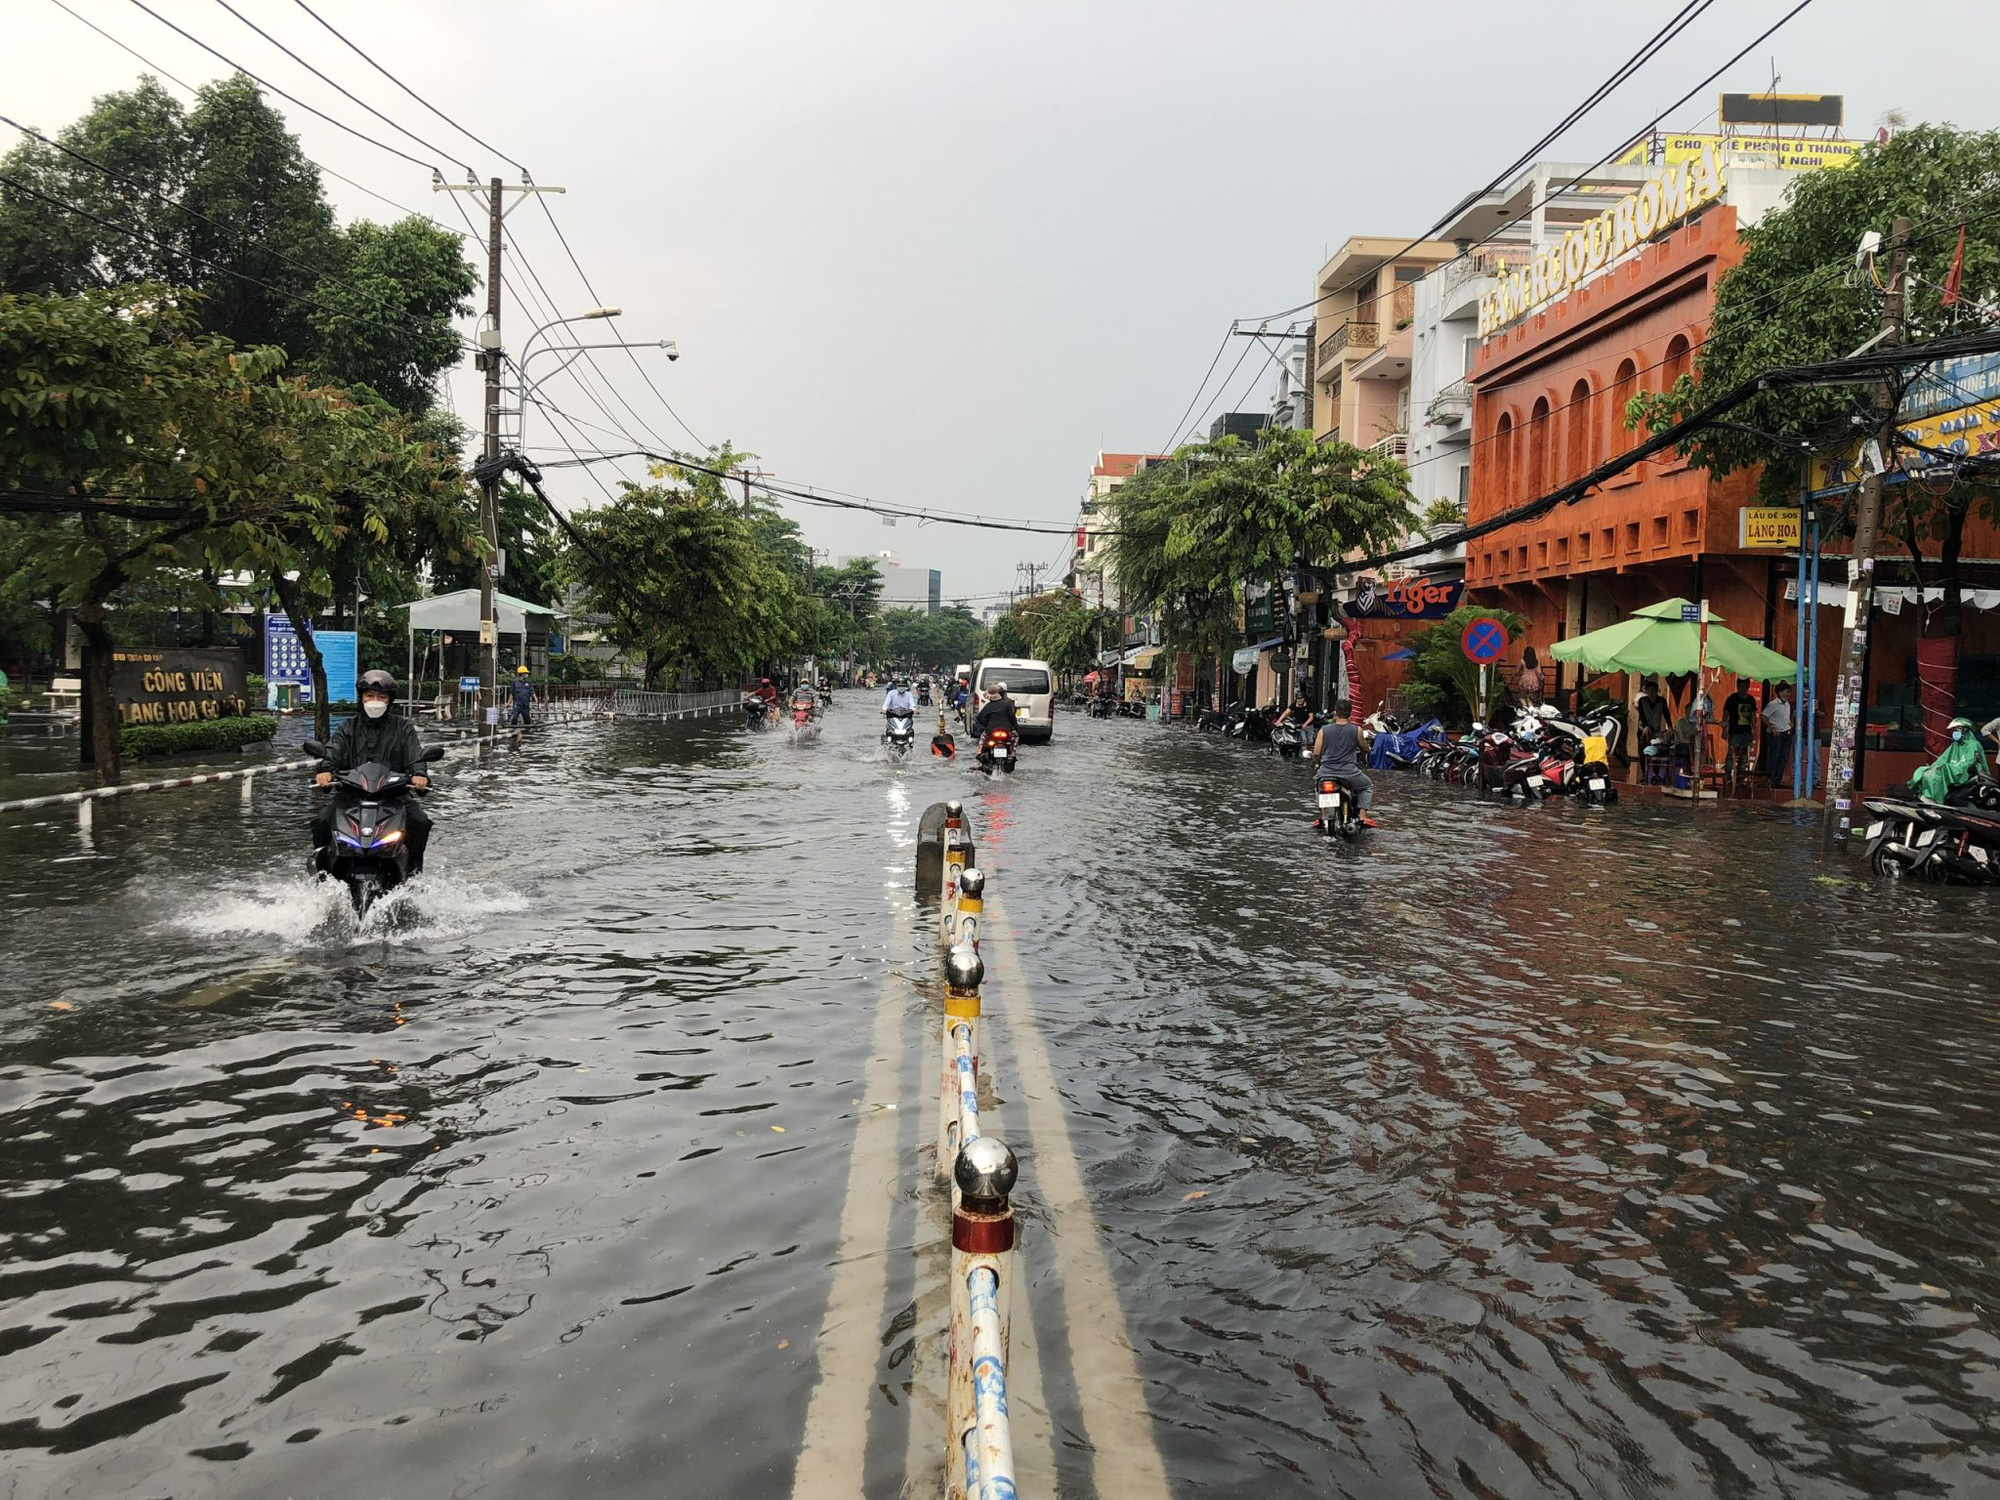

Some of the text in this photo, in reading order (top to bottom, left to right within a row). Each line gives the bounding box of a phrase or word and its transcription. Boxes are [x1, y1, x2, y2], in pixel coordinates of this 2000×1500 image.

[1674, 139, 1701, 150] CHO
[1613, 142, 1727, 257] ROMA
[1748, 521, 1798, 538] LÀNG HOA
[1385, 578, 1454, 614] Tiger
[144, 666, 223, 692] CÔNG VIÊN
[168, 701, 198, 722] HOA
